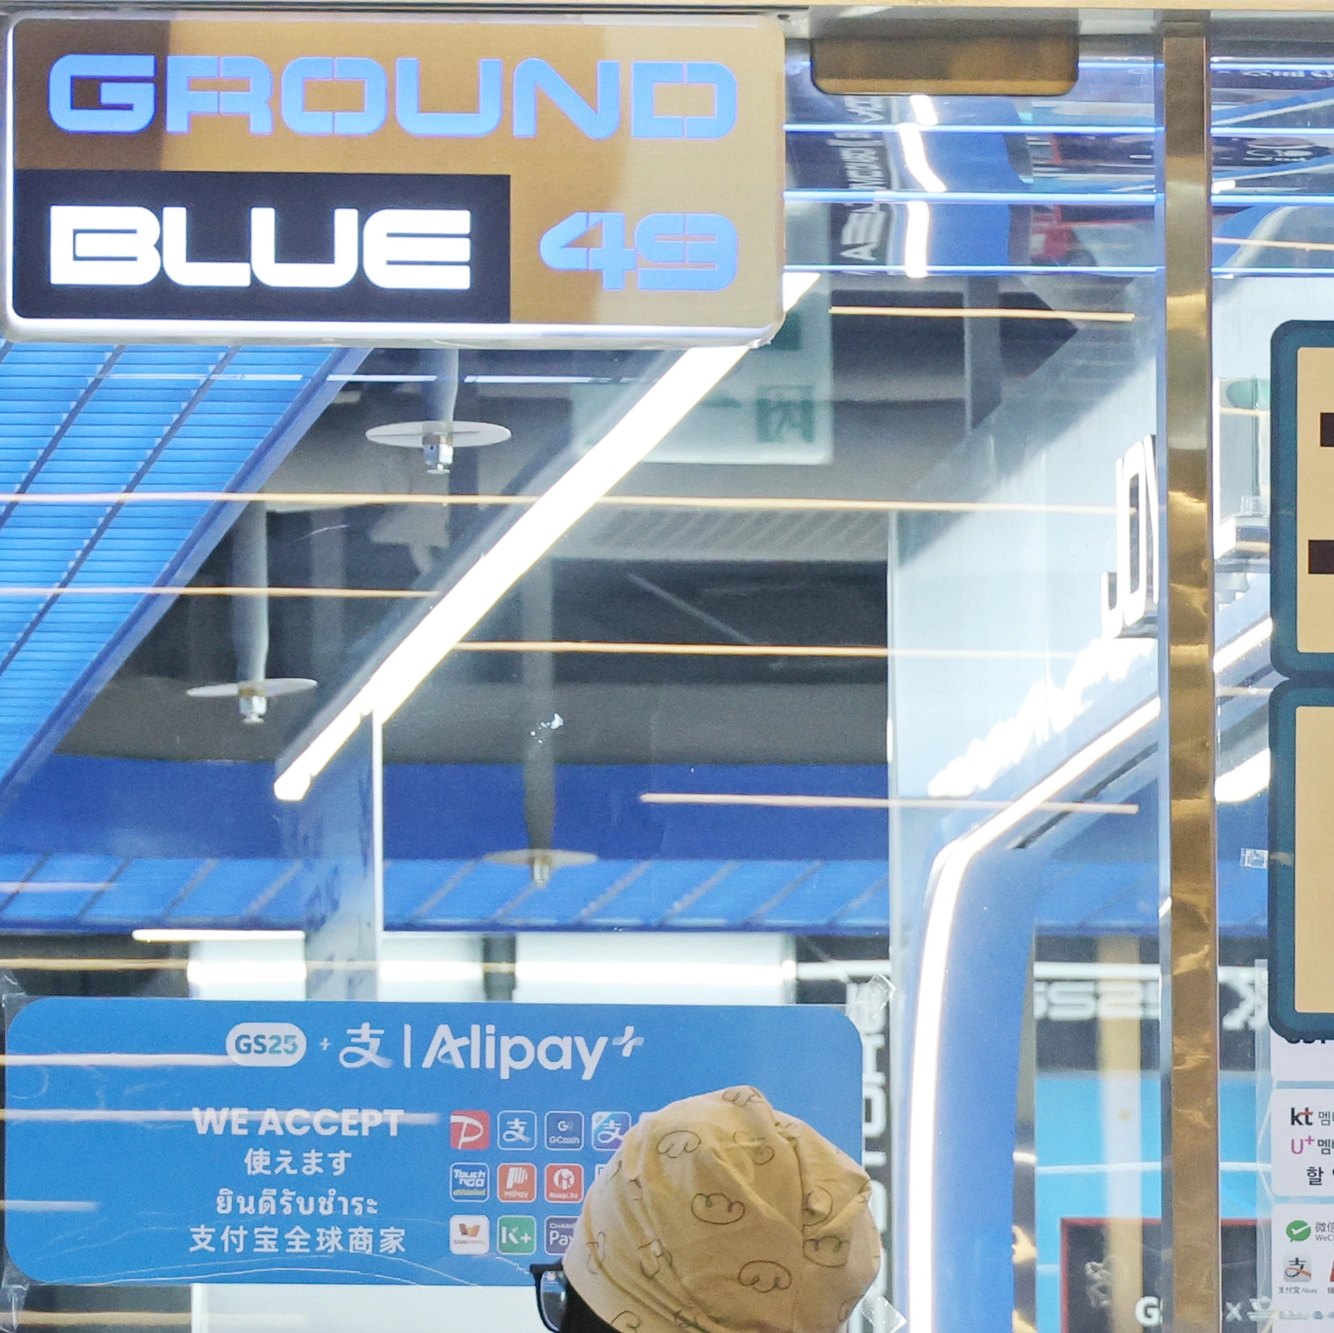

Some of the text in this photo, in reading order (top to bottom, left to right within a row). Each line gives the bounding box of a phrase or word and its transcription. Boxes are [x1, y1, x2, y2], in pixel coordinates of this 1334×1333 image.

[48, 53, 738, 140] GROUND
[50, 206, 738, 290] BLUE 49
[235, 1034, 298, 1055] GS25
[192, 1107, 405, 1137] WE ACCEPT
[1291, 1107, 1313, 1126] kt
[244, 1148, 352, 1176] 使えます
[189, 1224, 406, 1255] 支付宝全球商家
